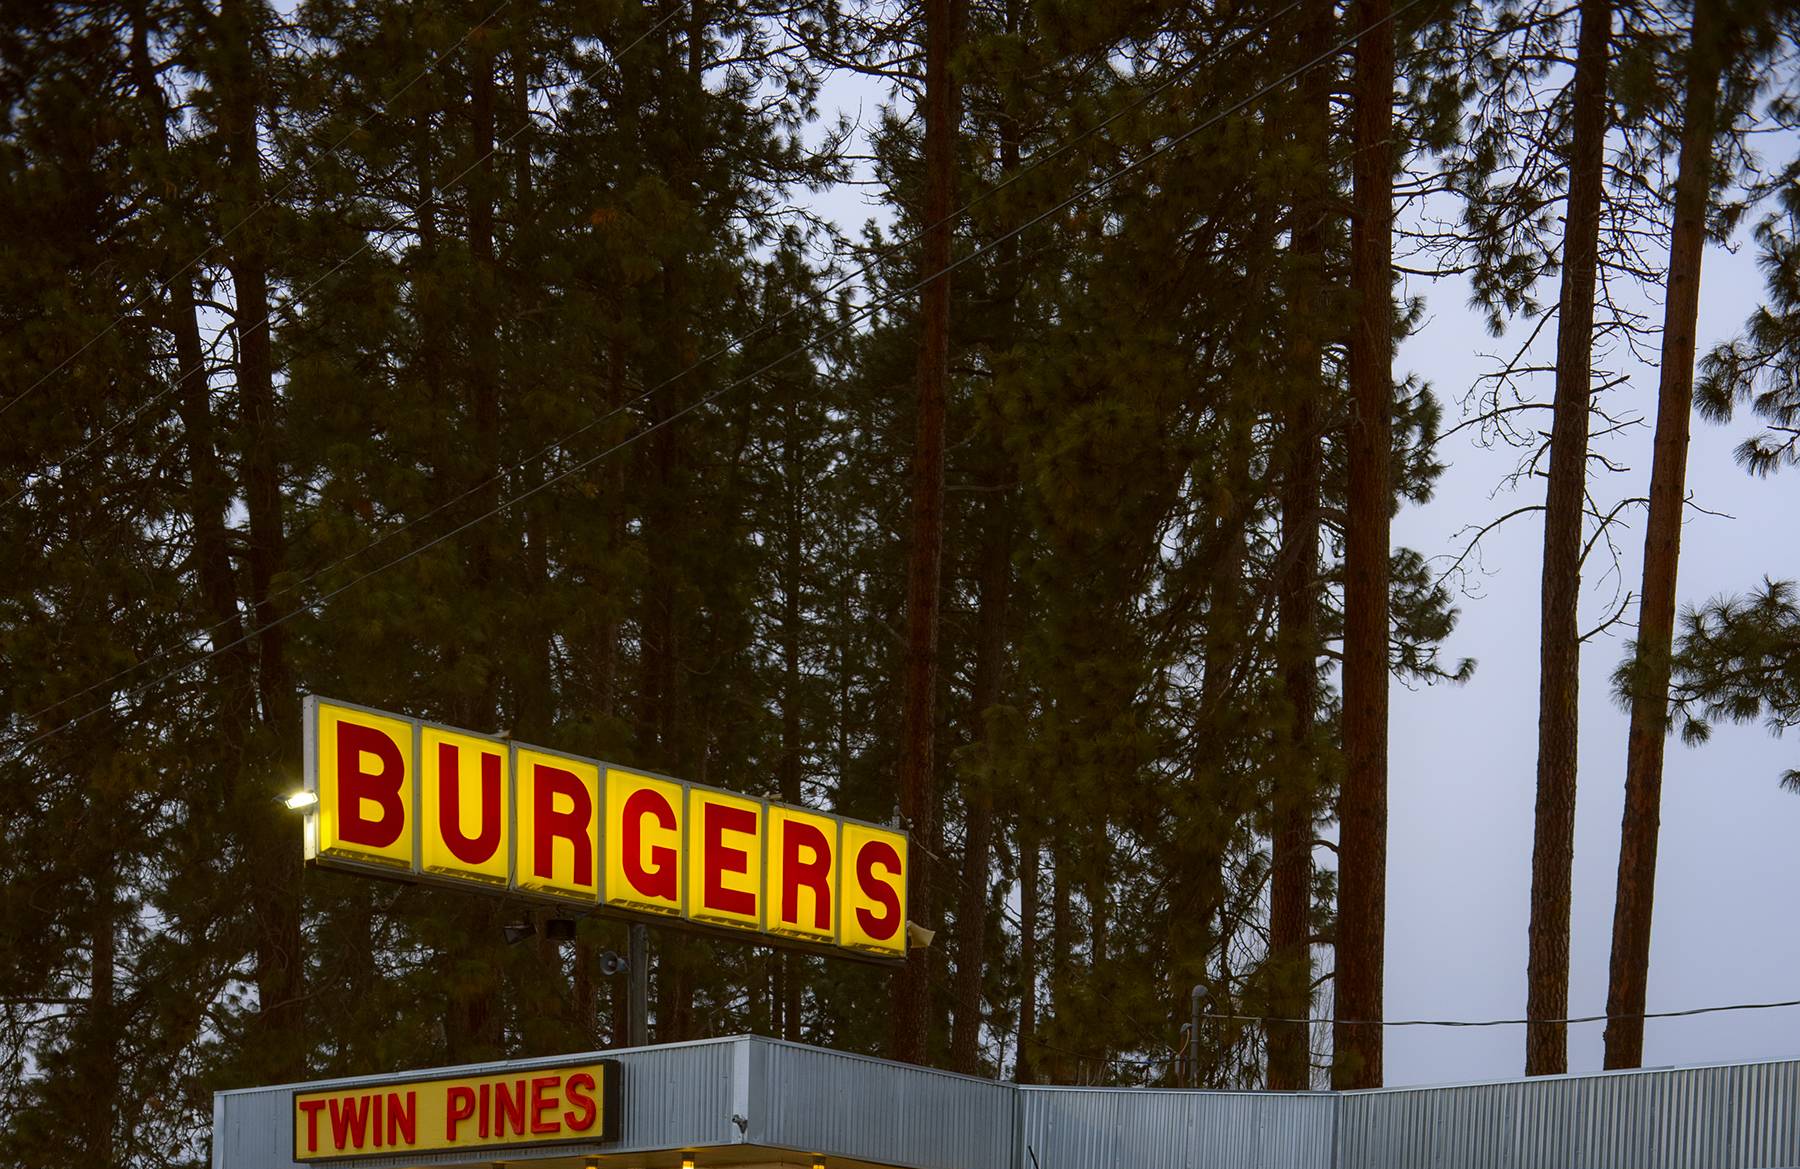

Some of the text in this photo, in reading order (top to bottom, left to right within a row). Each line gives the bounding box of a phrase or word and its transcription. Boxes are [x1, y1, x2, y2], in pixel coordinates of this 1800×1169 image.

[336, 720, 902, 941] BURGERS
[299, 1072, 598, 1152] TWIN PINES
